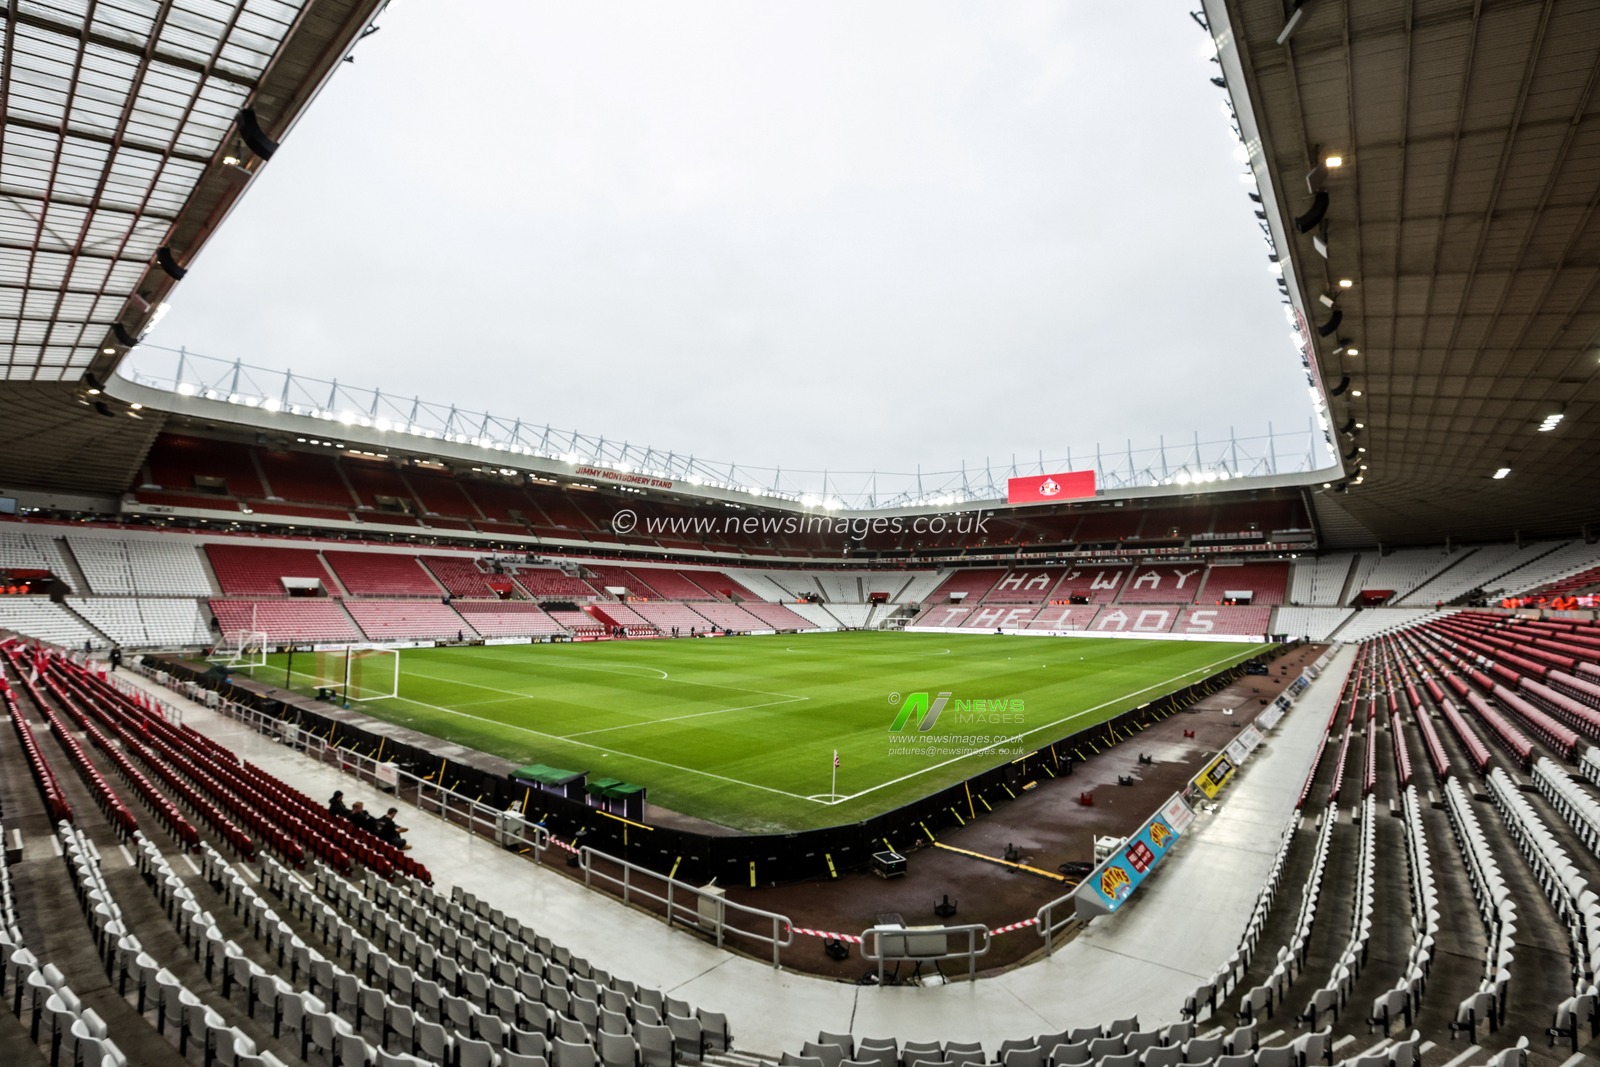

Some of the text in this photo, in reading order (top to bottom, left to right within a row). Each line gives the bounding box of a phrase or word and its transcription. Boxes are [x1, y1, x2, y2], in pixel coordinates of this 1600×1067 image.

[576, 467, 672, 489] JIMMY MONTGOMERY STAND
[940, 608, 1218, 633] THE LADS
[1149, 822, 1172, 848] SMYTHS
[1101, 866, 1131, 900] SMYTHS
